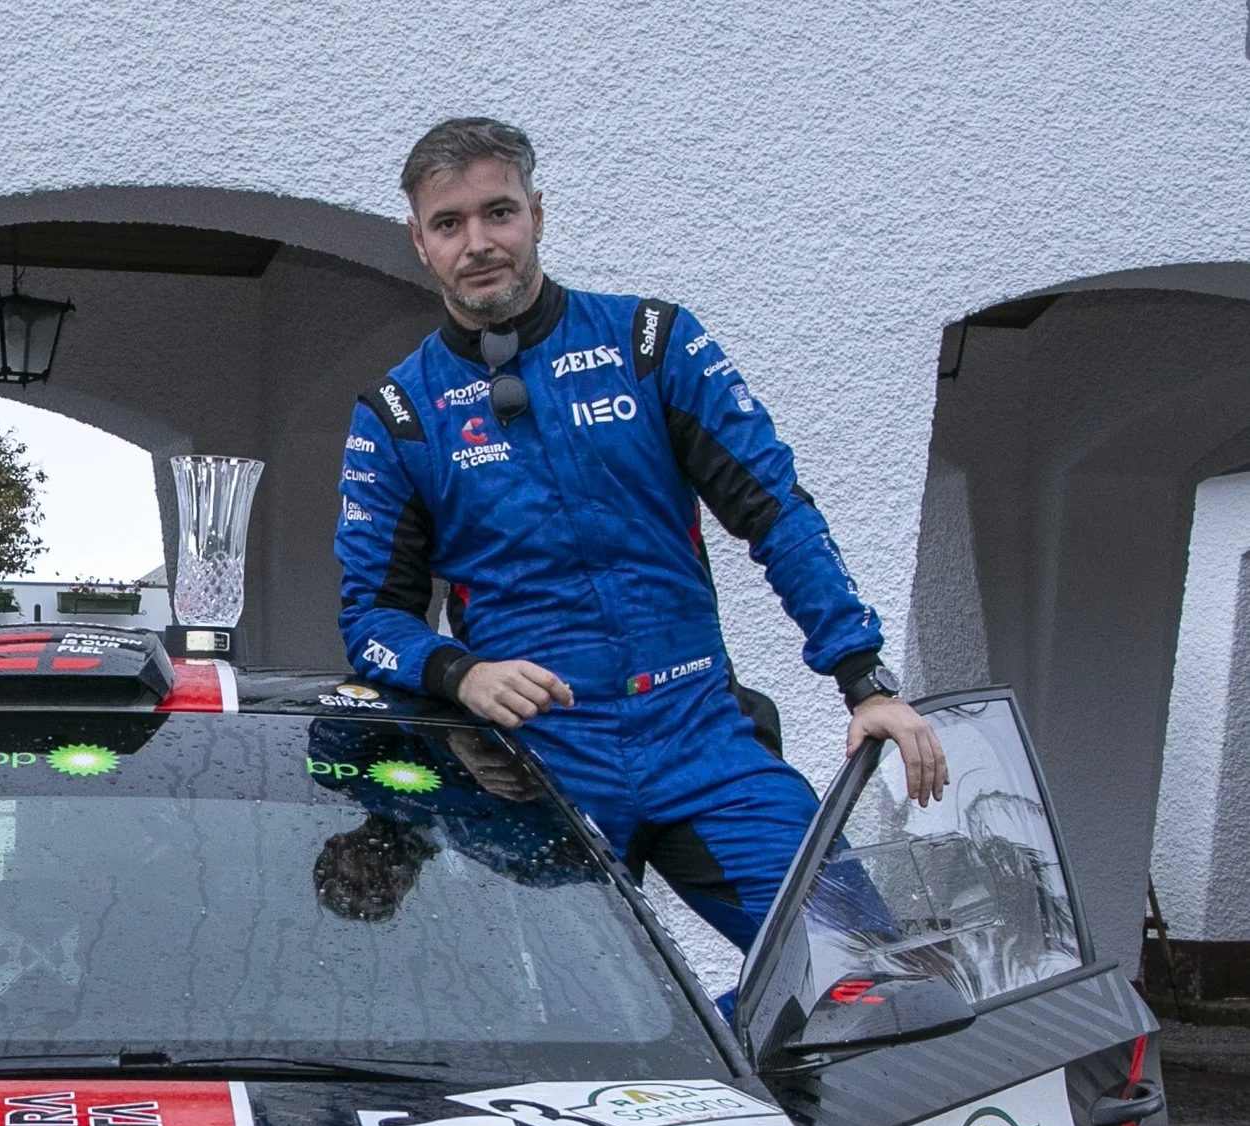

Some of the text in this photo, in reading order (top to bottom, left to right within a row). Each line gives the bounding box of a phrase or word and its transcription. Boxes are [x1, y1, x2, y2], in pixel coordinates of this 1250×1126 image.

[640, 308, 660, 357] Sabelt
[551, 345, 623, 378] ZEISS
[379, 384, 411, 424] Sabelt
[452, 441, 511, 462] CALDEIRA
[460, 452, 510, 470] & COSTA
[345, 469, 376, 483] CLINIC
[57, 645, 104, 654] FUEL
[64, 632, 143, 646] PASSION
[79, 638, 120, 649] OUR
[654, 656, 713, 685] M. CAIRES
[305, 757, 359, 779] bp
[612, 1093, 746, 1122] Santana
